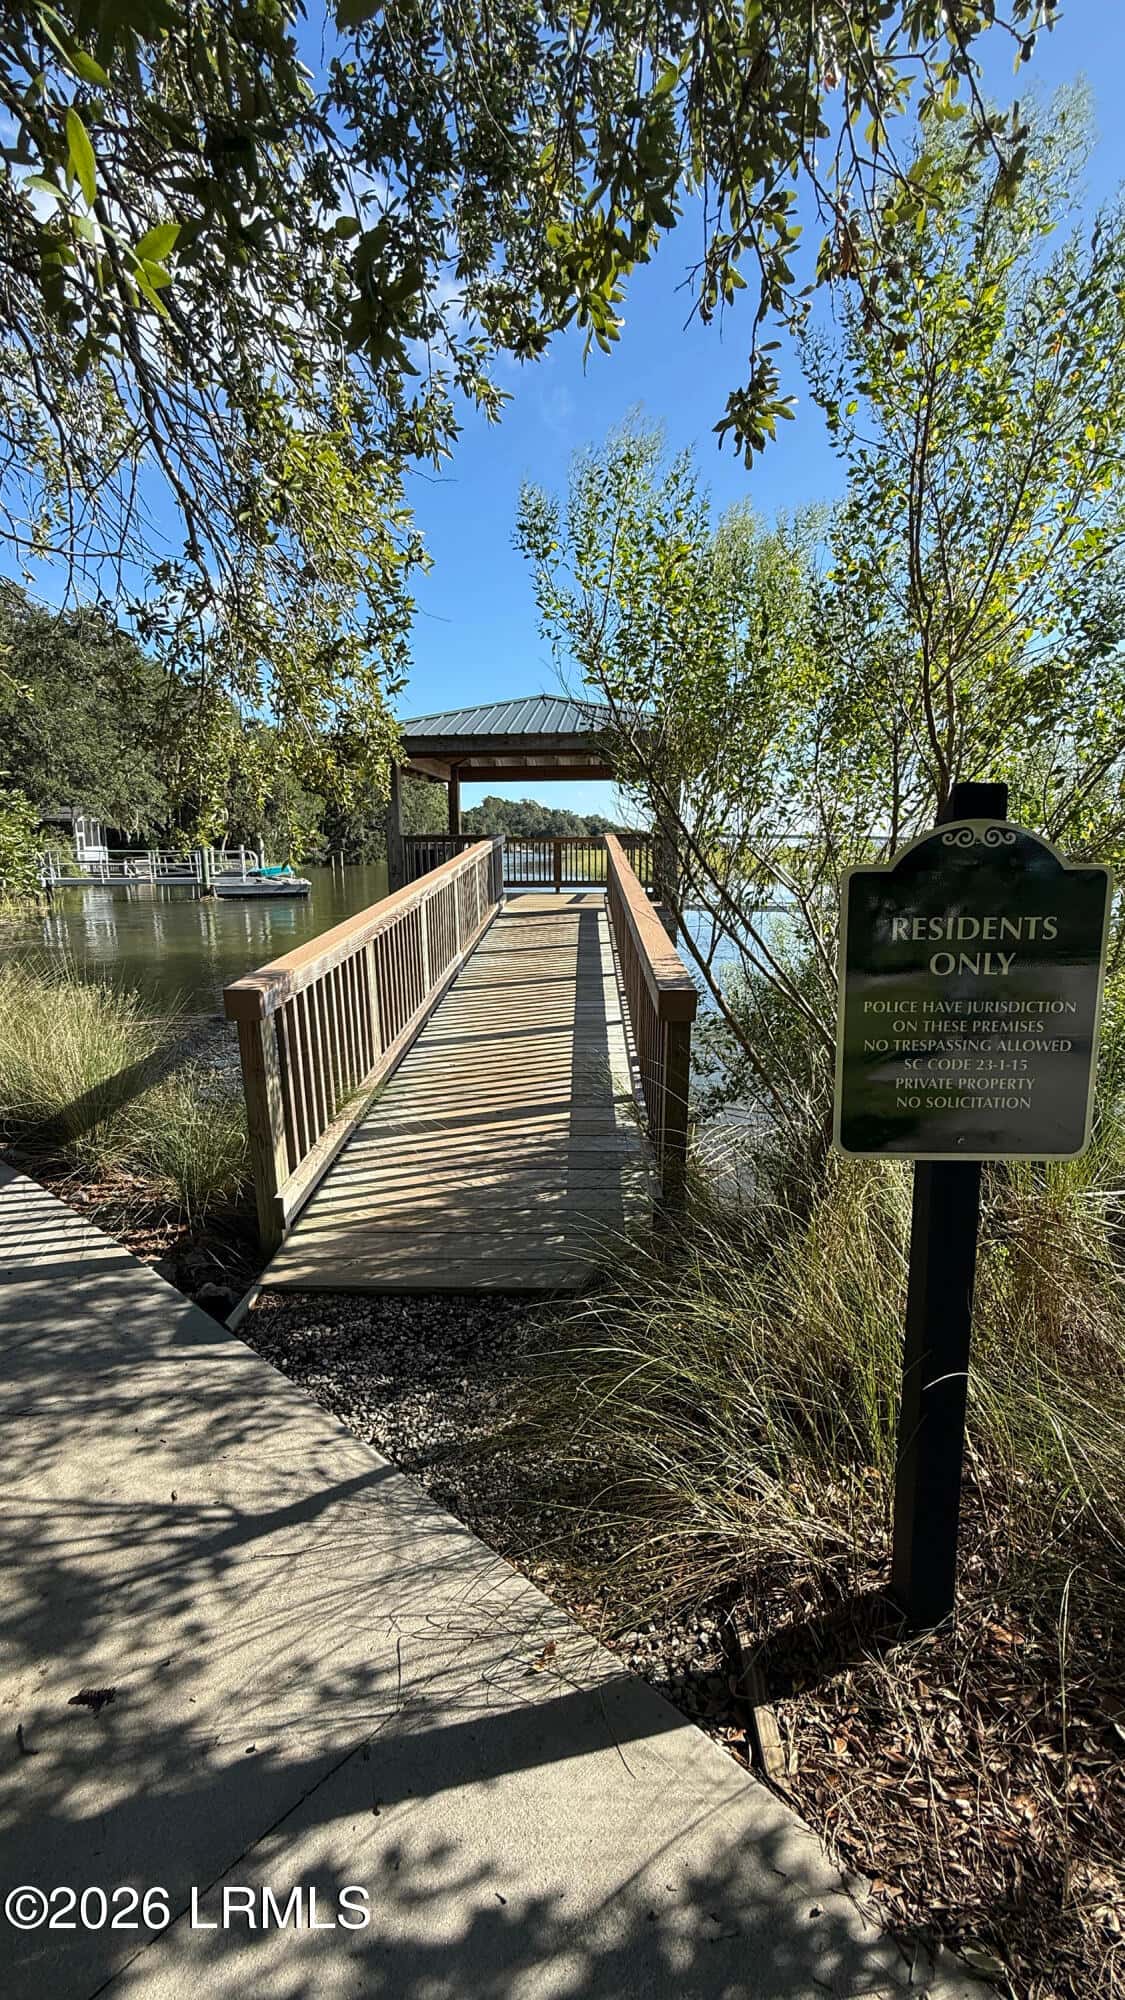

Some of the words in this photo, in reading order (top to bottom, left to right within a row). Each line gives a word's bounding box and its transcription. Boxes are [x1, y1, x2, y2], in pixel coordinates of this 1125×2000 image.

[891, 916, 1058, 941] RESIDENTS
[930, 952, 1016, 976] ONLY
[864, 1001, 917, 1013] POLICE
[922, 1001, 962, 1013] HAVE
[967, 1001, 1076, 1015] JURISDICTION
[893, 1020, 918, 1033] ON
[922, 1020, 968, 1033] THESE
[972, 1020, 1044, 1033] PREMISES
[864, 1039, 889, 1052] NO
[894, 1039, 991, 1052] TRESPASSING
[997, 1039, 1071, 1052] ALLOWED
[904, 1058, 922, 1070] SC
[927, 1058, 971, 1070] CODE
[976, 1059, 1028, 1070] 23-1-15
[895, 1078, 953, 1089] PRIVATE
[958, 1078, 1035, 1090] PROPERTY
[896, 1097, 921, 1109] NO
[925, 1096, 1031, 1109] SOLICITATION
